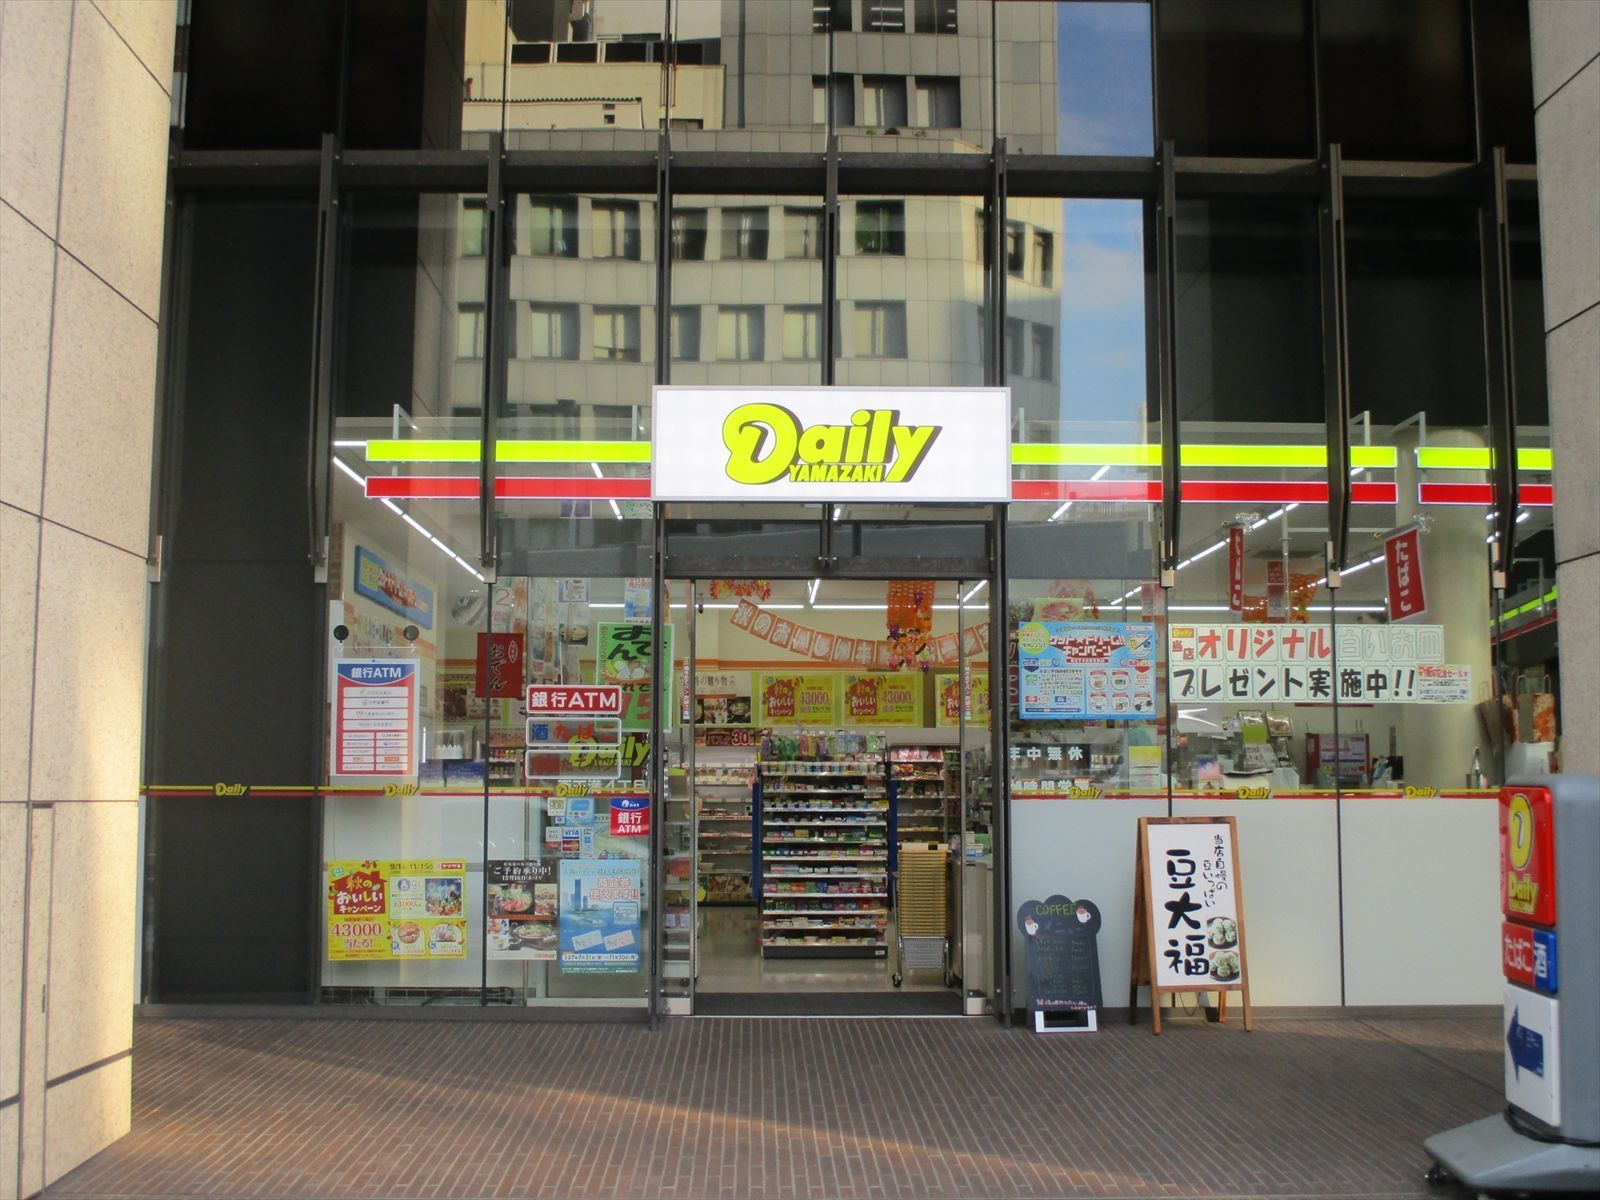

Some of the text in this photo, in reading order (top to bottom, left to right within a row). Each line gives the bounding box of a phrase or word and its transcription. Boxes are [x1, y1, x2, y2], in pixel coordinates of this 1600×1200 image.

[722, 402, 942, 485] Daily
[789, 464, 887, 483] YAMAZAKI
[1395, 540, 1412, 612] たばこ
[1172, 639, 1194, 660] 当店
[351, 667, 401, 678] 銀行ATM
[1173, 667, 1416, 699] プレゼント実施中!!
[531, 691, 616, 708] 銀行ATM
[532, 723, 548, 740] 酒
[215, 783, 247, 796] Daily
[384, 784, 418, 797] Daily
[555, 784, 590, 797] Daily
[1070, 786, 1102, 799] Daily
[1237, 786, 1271, 799] Daily
[1404, 786, 1438, 799] Daily
[617, 812, 642, 824] 銀行
[617, 825, 642, 833] ATM
[346, 876, 372, 891] 秋の
[336, 891, 383, 905] おいしい
[1508, 871, 1538, 913] Daily
[339, 905, 381, 914] キャンペーン
[1036, 903, 1077, 916] COFFEE
[1164, 849, 1210, 976] 豆大福
[1504, 934, 1532, 973] たばこ
